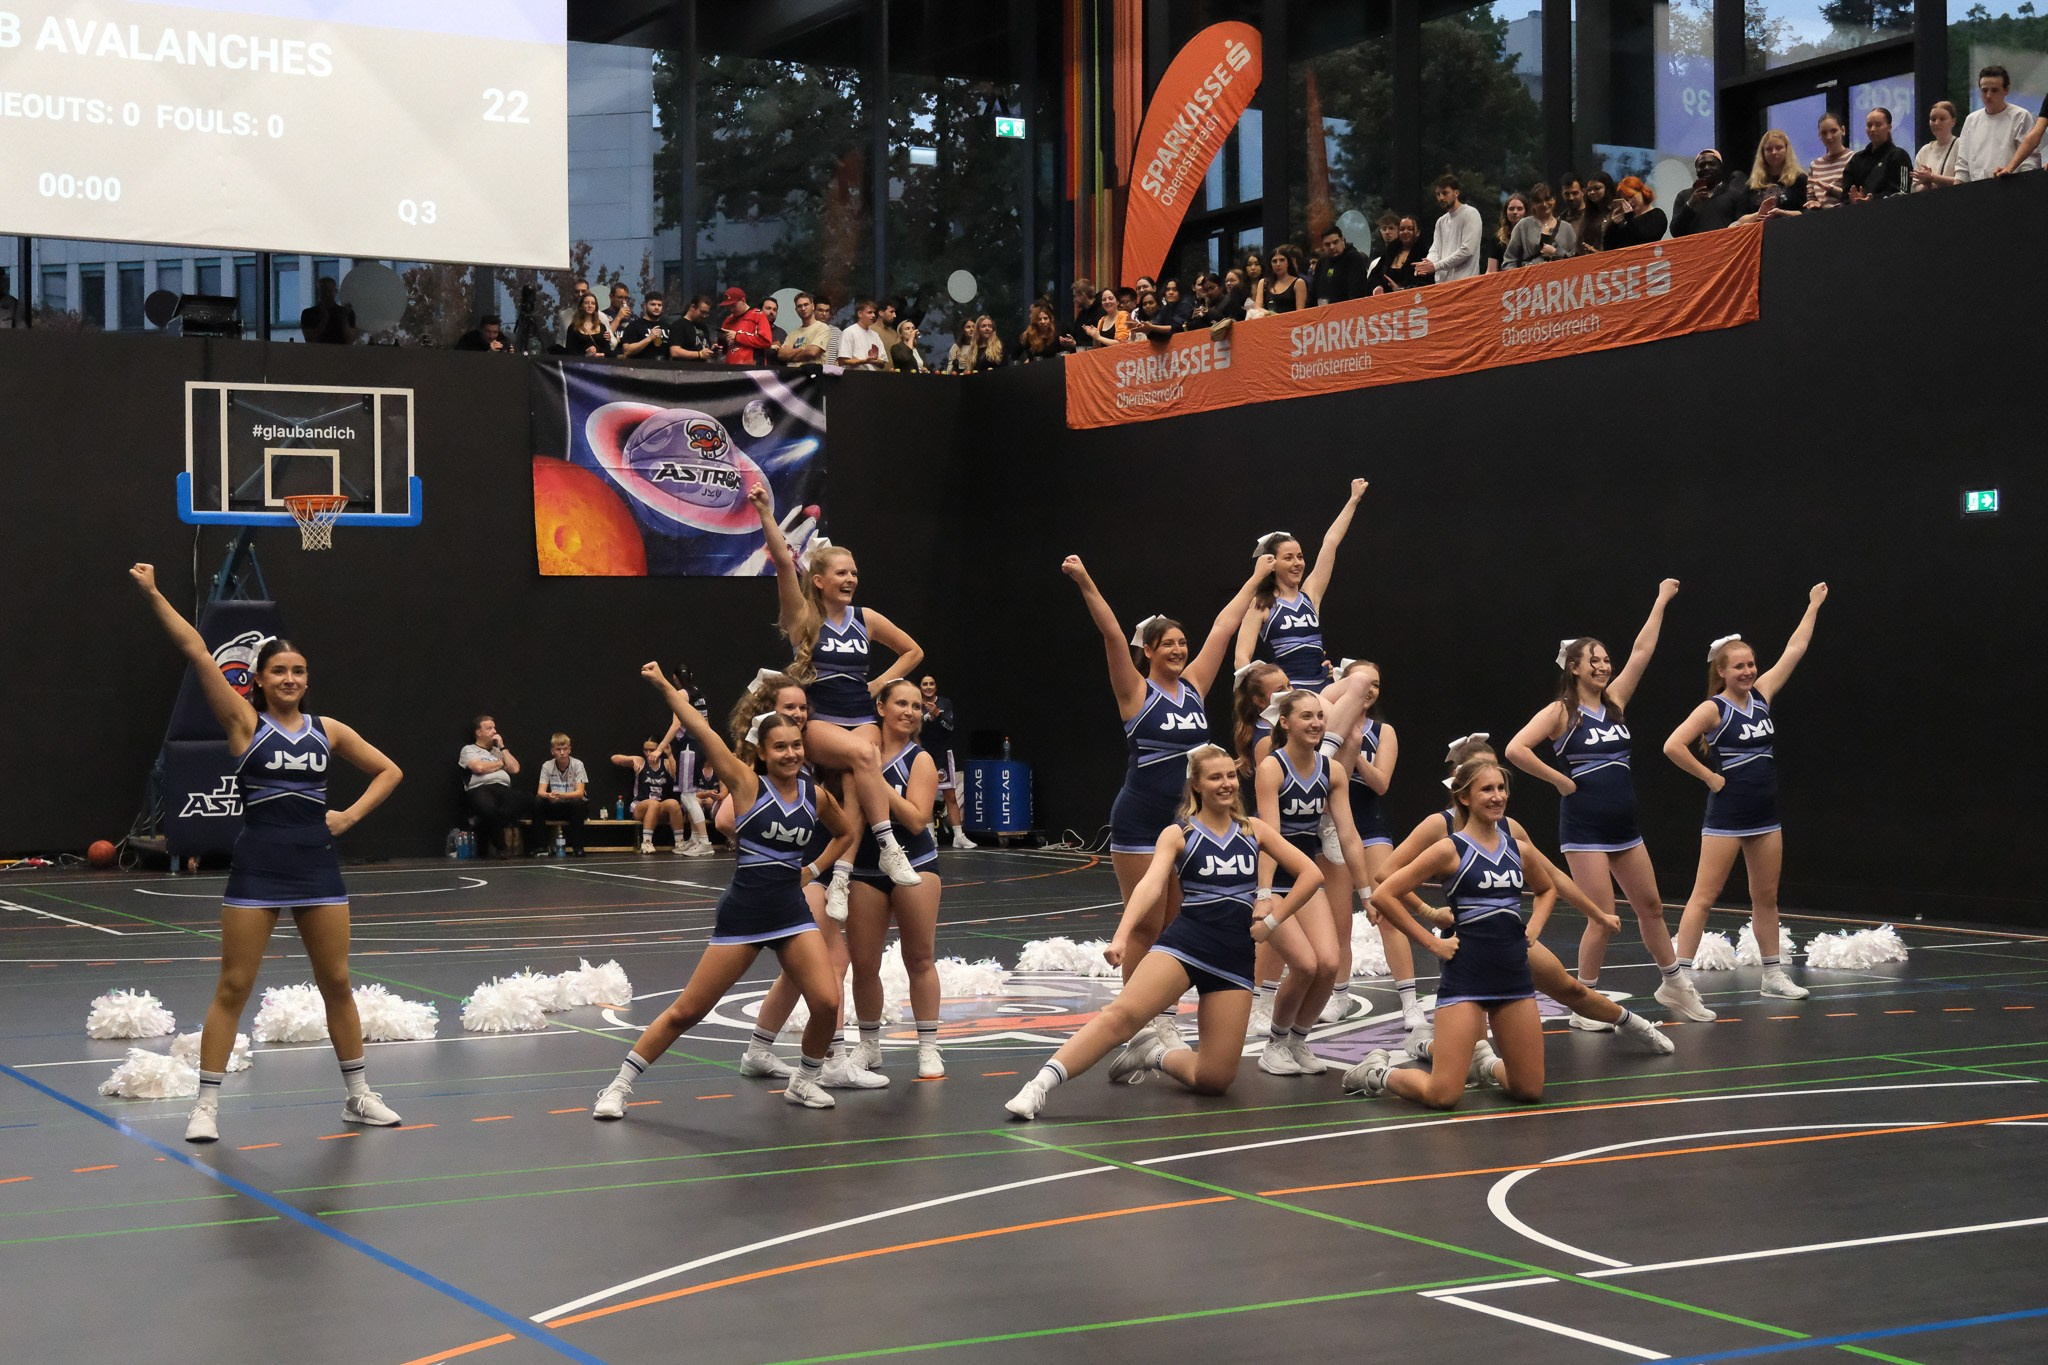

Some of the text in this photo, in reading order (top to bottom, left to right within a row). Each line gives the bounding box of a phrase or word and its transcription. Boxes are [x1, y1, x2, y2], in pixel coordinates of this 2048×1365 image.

[35, 16, 333, 77] AVALANCHES
[0, 91, 284, 139] EOUTS: 0 FOULS: 0
[482, 88, 530, 124] 22
[1142, 62, 1232, 197] SPARKASSE
[1160, 113, 1220, 206] Oberösterreich
[39, 172, 121, 202] 00:00
[398, 199, 437, 226] Q3
[1502, 265, 1641, 323] SPARKASSE
[645, 328, 670, 339] JU
[1291, 310, 1405, 358] SPARKASSE
[1502, 314, 1600, 347] Oberösterreich
[1115, 343, 1211, 388] SPARKASSE
[1291, 352, 1372, 380] Oberösterreich
[1116, 384, 1184, 409] Oberösterreich
[252, 424, 355, 441] #glaubandich
[1280, 613, 1319, 630] JKU
[820, 637, 868, 655] JKU
[1159, 712, 1208, 730] JKU
[1738, 718, 1775, 741] JKU
[1584, 724, 1631, 746] JKU
[265, 750, 327, 772] JKU
[178, 793, 244, 818] AST
[975, 769, 983, 822] LINZ AG
[1002, 769, 1010, 825] LINZ AG
[1282, 798, 1327, 816] JKU
[761, 821, 813, 846] JKU
[1198, 854, 1255, 876] JKU
[1477, 870, 1524, 889] JKU
